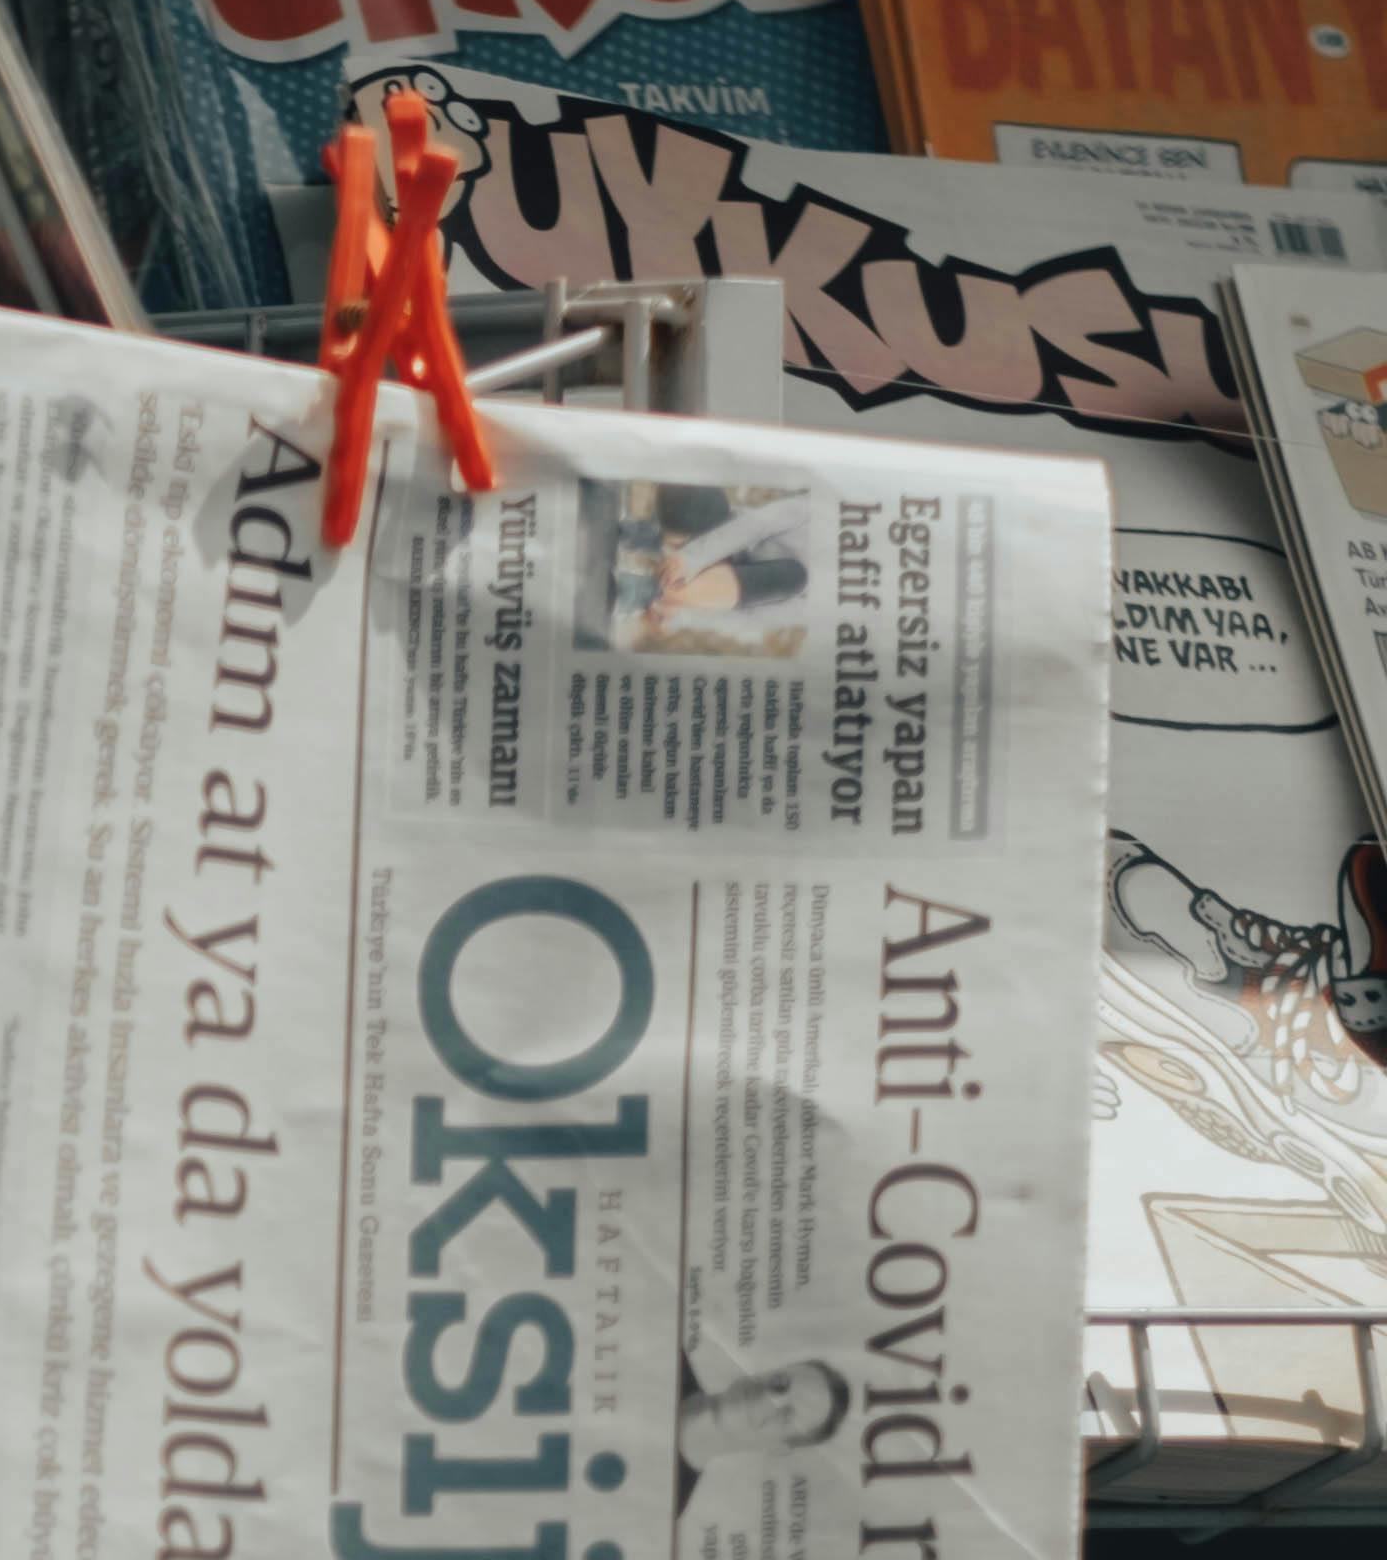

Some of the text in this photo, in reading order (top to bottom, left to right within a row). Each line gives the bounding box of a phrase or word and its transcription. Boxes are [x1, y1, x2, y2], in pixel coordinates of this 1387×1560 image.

[619, 76, 772, 116] TAKVİM
[209, 414, 322, 733] Adım
[480, 494, 537, 807] Yürüyüş zamanı
[822, 502, 881, 822] hafif atlatıyor
[883, 496, 941, 834] Egzersiz yapan
[1114, 569, 1251, 603] YAKKABI
[1114, 602, 1288, 645] DIM YAA,
[1167, 638, 1237, 673] VAR
[163, 912, 258, 1047] ya
[195, 770, 276, 877] at
[173, 1083, 278, 1225] da
[355, 867, 392, 1323] Türkiye'nin Tek Hafta Sonu Gazetesi
[713, 880, 740, 1273] sistemini güçlendirecek reçetelerini veriyor.
[735, 881, 771, 1348] tavuklu çorba tarifine kadar Covid'e karşı bağışıklık
[767, 882, 797, 1310] reçetesiz satılan gıda takviyelerinden annesinin
[796, 883, 829, 1288] Dünyaca ünlü Amerikalı doktor Mark Hyman,
[861, 882, 993, 1485] Anti-Covid
[593, 1188, 623, 1417] HAFTALIK
